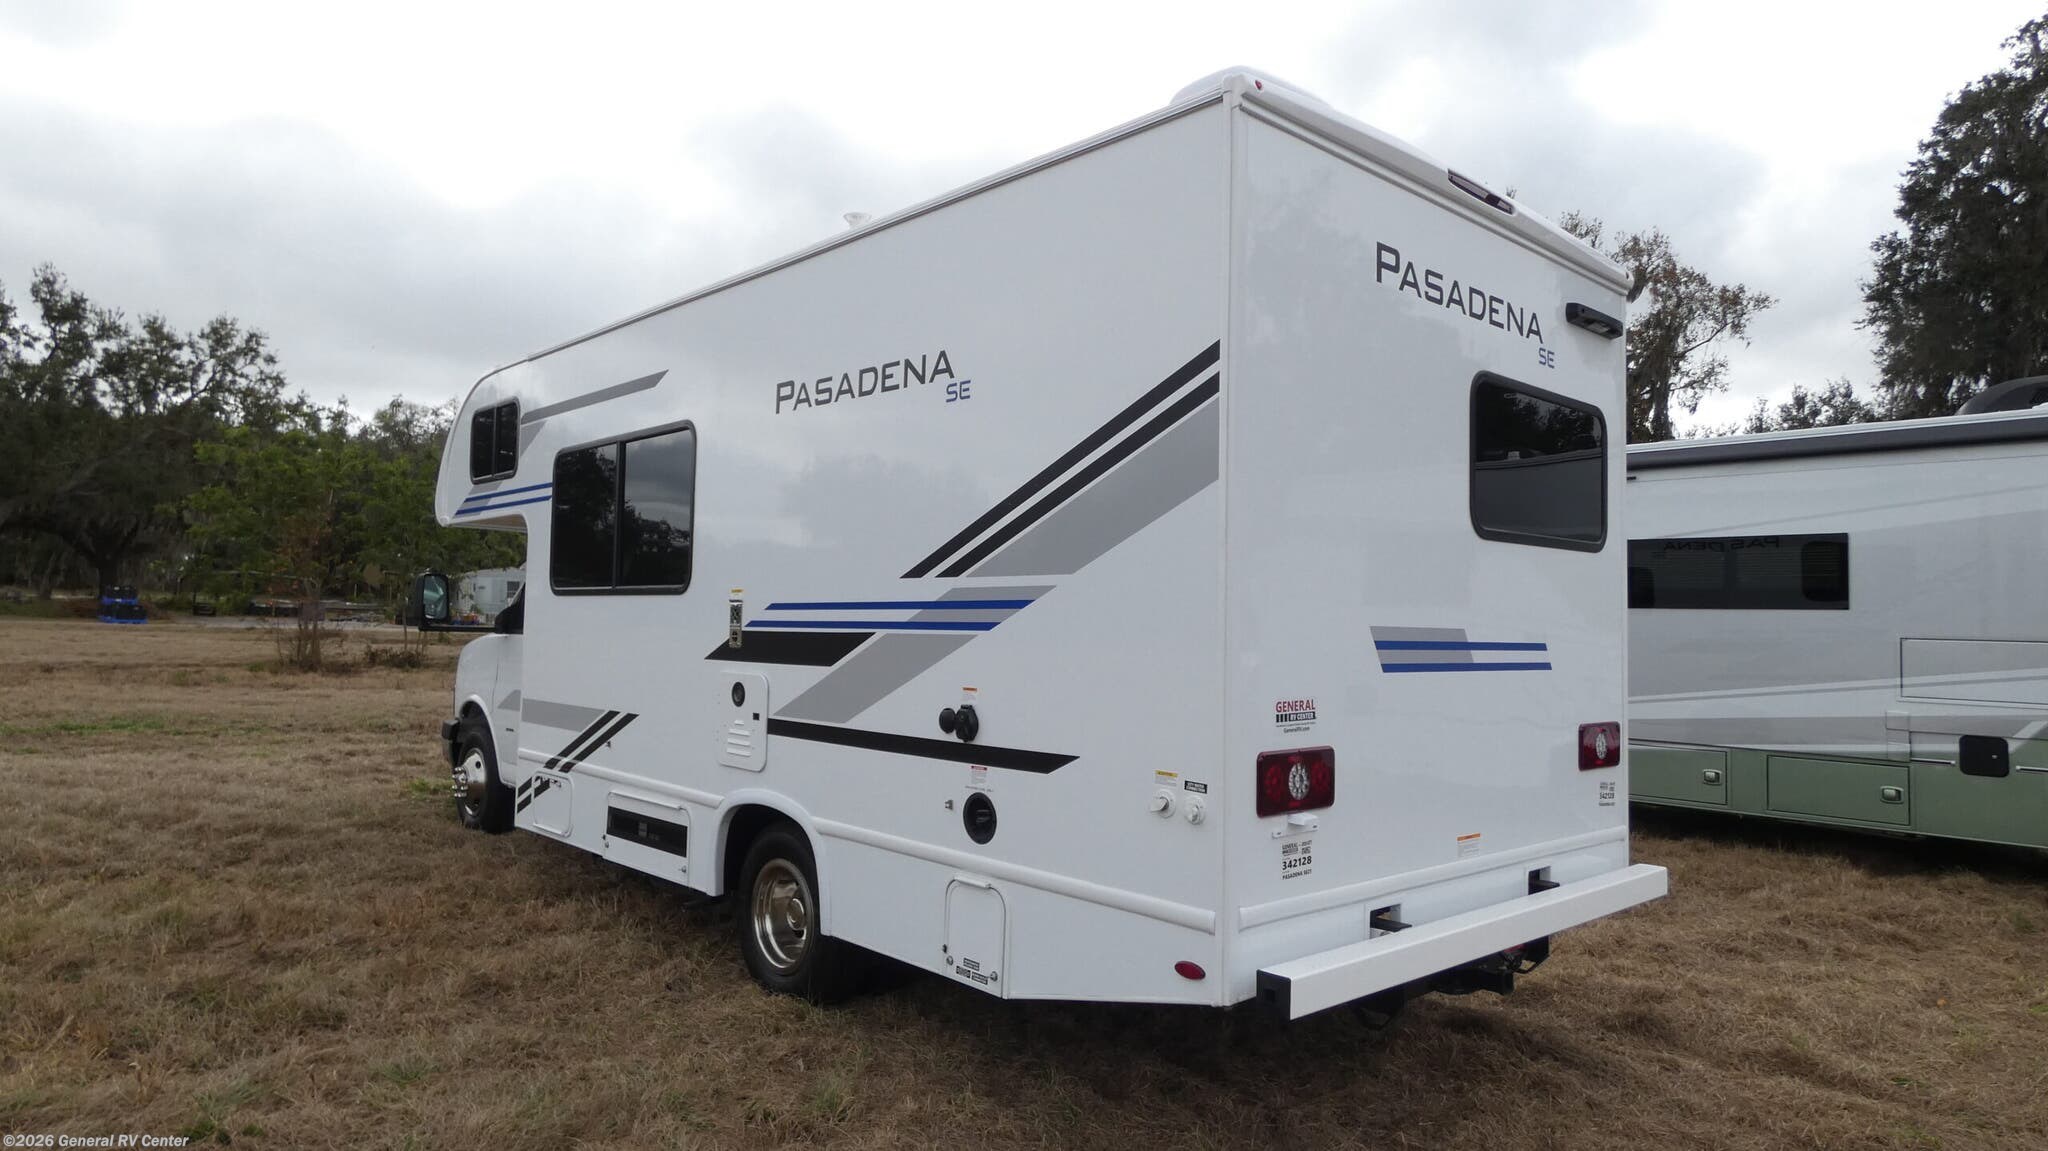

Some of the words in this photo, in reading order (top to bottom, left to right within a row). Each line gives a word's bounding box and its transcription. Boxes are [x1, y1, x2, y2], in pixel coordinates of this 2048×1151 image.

[1376, 241, 1543, 345] PASADENA
[1538, 347, 1555, 369] SE
[775, 350, 955, 415] PASADENA
[945, 379, 972, 403] SE
[1276, 699, 1315, 713] GENERAL
[1297, 711, 1314, 720] CENTER
[1282, 855, 1312, 870] 342128
